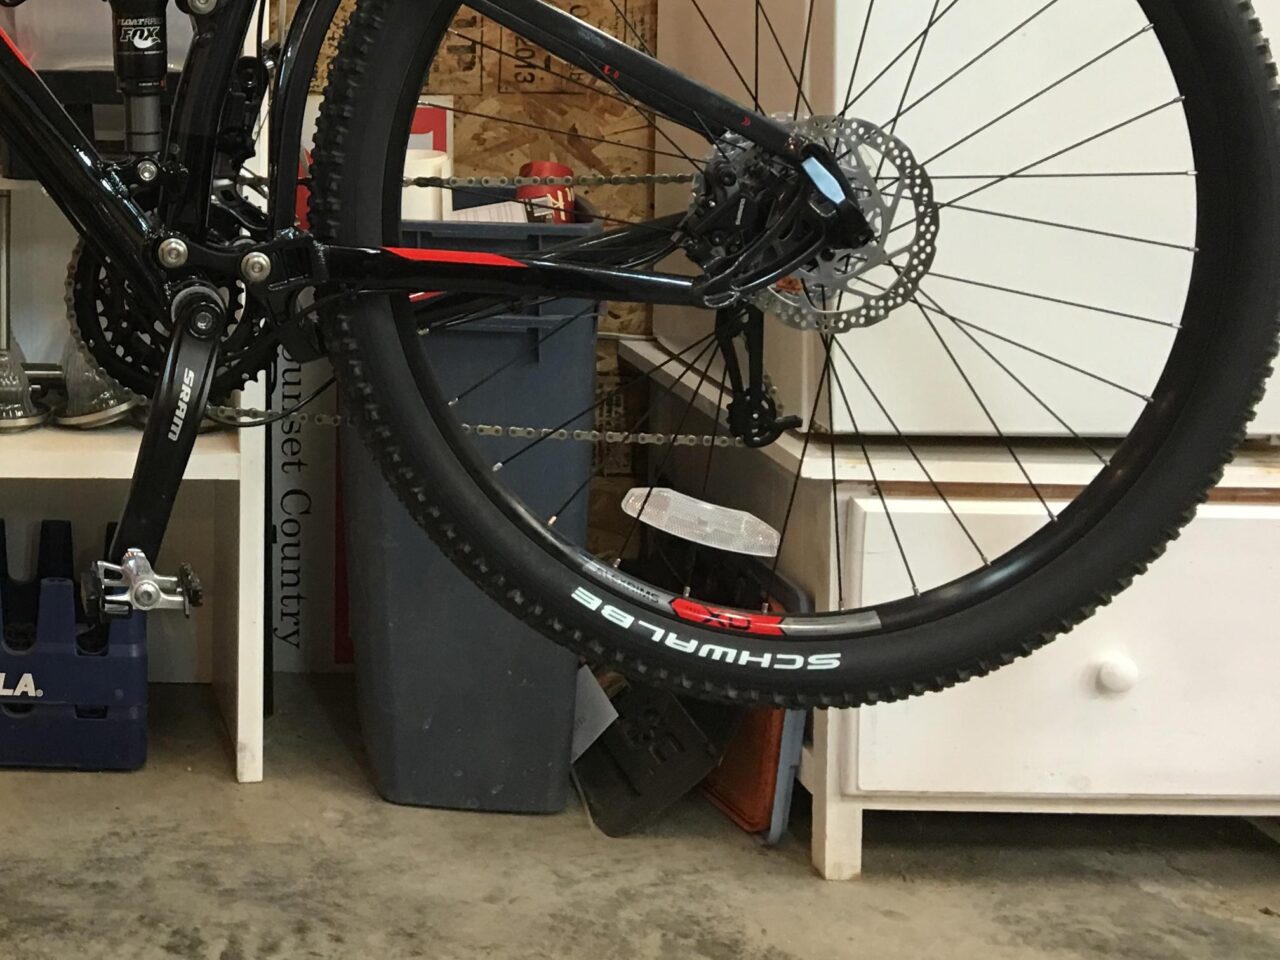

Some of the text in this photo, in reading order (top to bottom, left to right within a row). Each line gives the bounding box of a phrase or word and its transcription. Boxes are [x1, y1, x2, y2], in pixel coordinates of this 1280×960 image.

[120, 26, 161, 48] FOX
[167, 367, 195, 442] SRAM
[273, 488, 312, 650] Country
[571, 587, 842, 670] SCHWALBE
